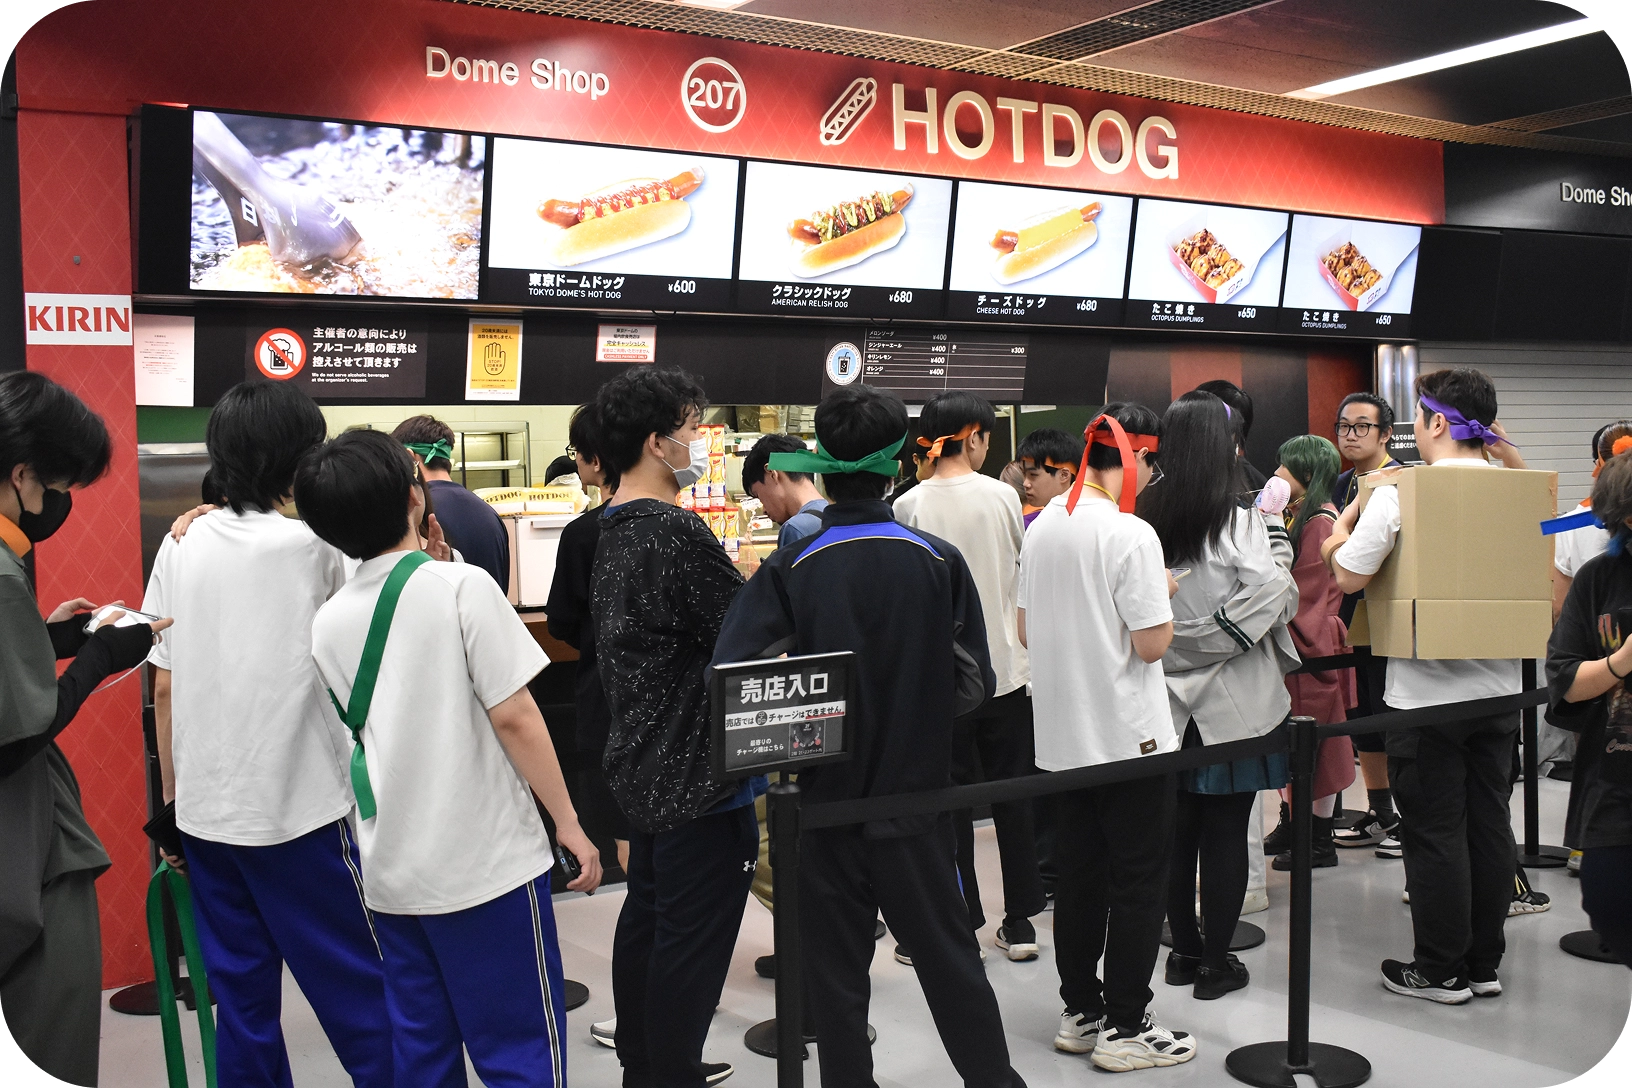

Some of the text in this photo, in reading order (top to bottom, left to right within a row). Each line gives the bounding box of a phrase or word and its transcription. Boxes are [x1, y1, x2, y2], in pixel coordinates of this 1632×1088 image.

[426, 46, 610, 100] Dome Shop
[688, 77, 740, 110] 207
[892, 83, 1179, 180] HOTDOG
[1561, 182, 1632, 207] Dome Sh
[528, 272, 626, 290] 東京ドームドッグ
[668, 280, 696, 294] ¥600
[528, 287, 622, 299] TOKYO DOME'S HOT DOG
[772, 284, 852, 300] クラシックドッグ
[889, 291, 913, 303] ¥680
[771, 298, 849, 309] AMERICAN RELISH DOG
[977, 294, 1047, 308] チーズドッグ
[1076, 300, 1098, 311] ¥680
[976, 306, 999, 315] CHEESE
[1013, 308, 1025, 316] DOG
[1152, 302, 1196, 316] たこ焼き
[1238, 307, 1257, 319] ¥650
[28, 305, 130, 332] KIRIN
[1151, 314, 1205, 323] OCTOPUS DUMPLINGS
[1302, 310, 1340, 323] たこ焼き
[1375, 314, 1392, 325] ¥650
[1301, 321, 1322, 329] OCTOPUS
[312, 327, 407, 340] 主催者の意向により
[312, 342, 418, 354] アルコール類の販売は
[312, 356, 402, 368] 控えさせて頂きます
[483, 490, 522, 503] OTDOG
[740, 673, 828, 704] 売店入口
